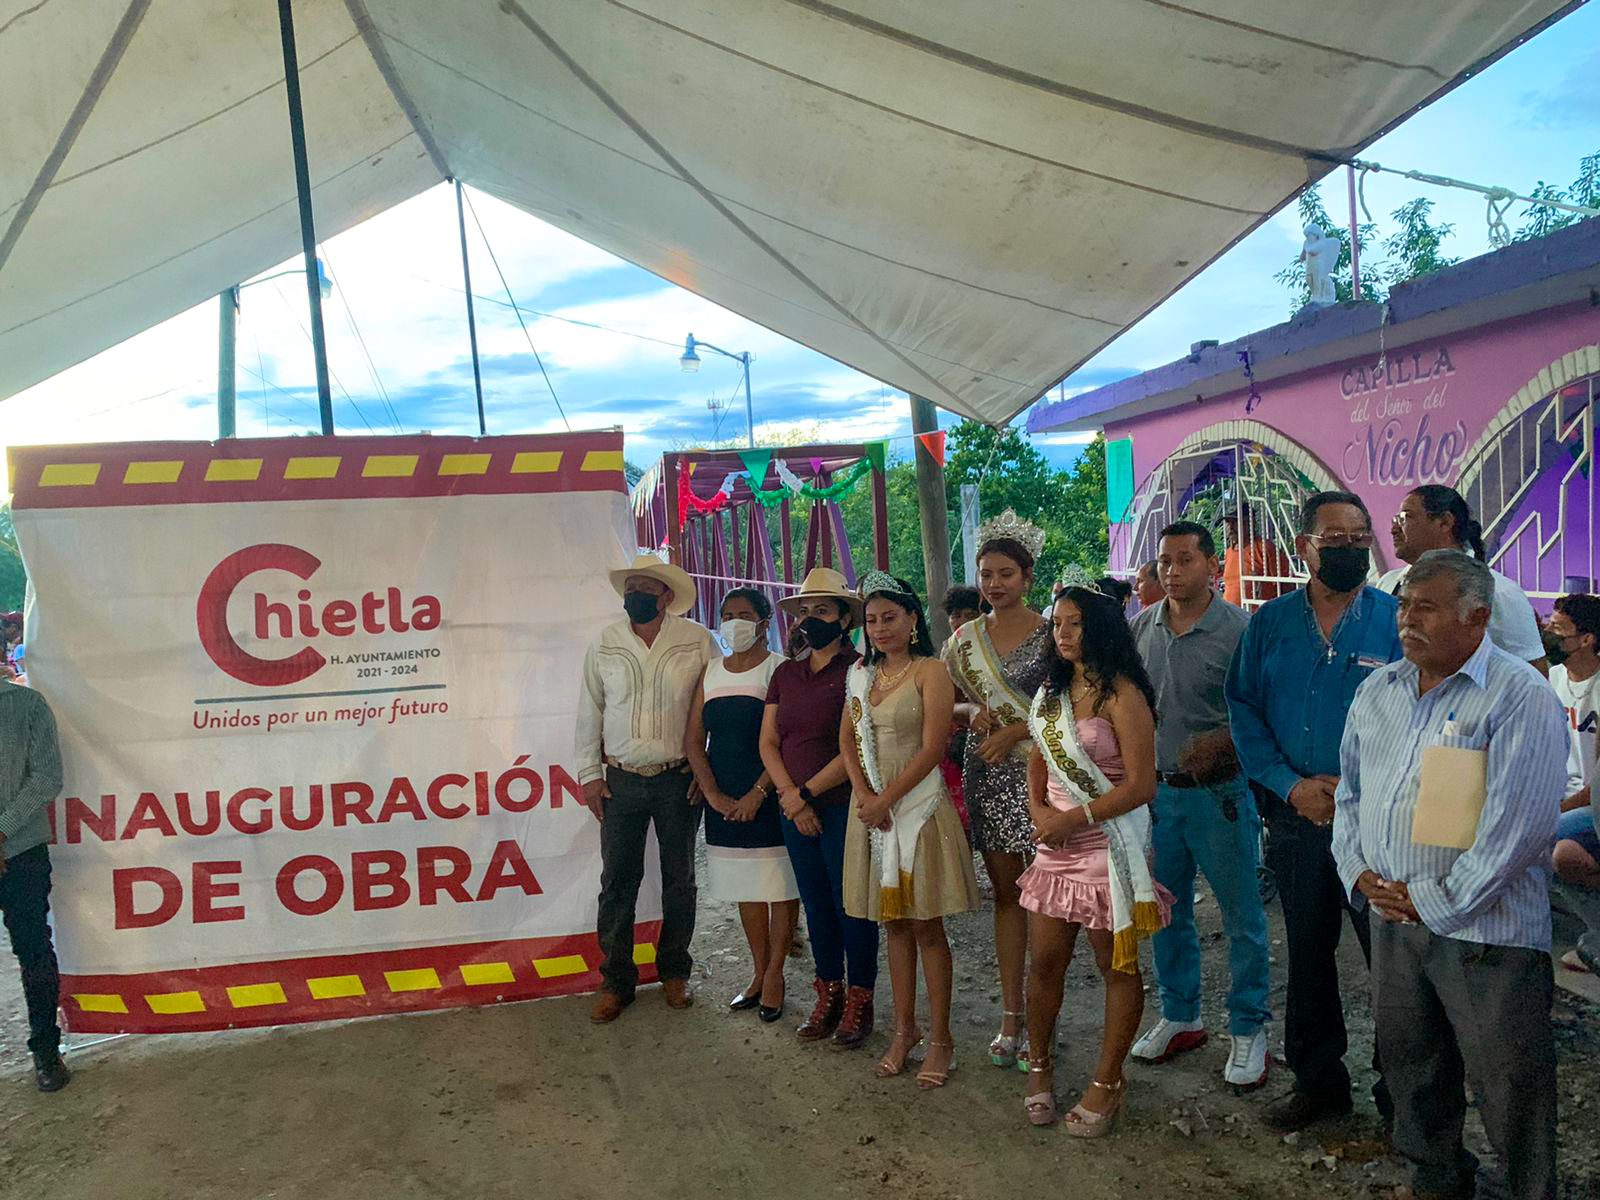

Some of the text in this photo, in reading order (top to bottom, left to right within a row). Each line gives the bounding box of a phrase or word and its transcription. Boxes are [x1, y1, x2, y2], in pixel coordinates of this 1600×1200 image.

[1341, 349, 1456, 399] CAPILLA
[1351, 398, 1370, 423] del
[1423, 383, 1447, 409] del
[1342, 414, 1469, 486] Nicho
[197, 543, 441, 686] Chietla
[330, 648, 441, 665] H. AYUNTAMIENTO
[357, 667, 382, 678] 2021
[391, 665, 418, 676] 2024
[193, 699, 448, 732] Unidos por un mejor futuro
[47, 754, 588, 845] INAUGURACIÓN
[113, 840, 543, 930] DE OBRA
